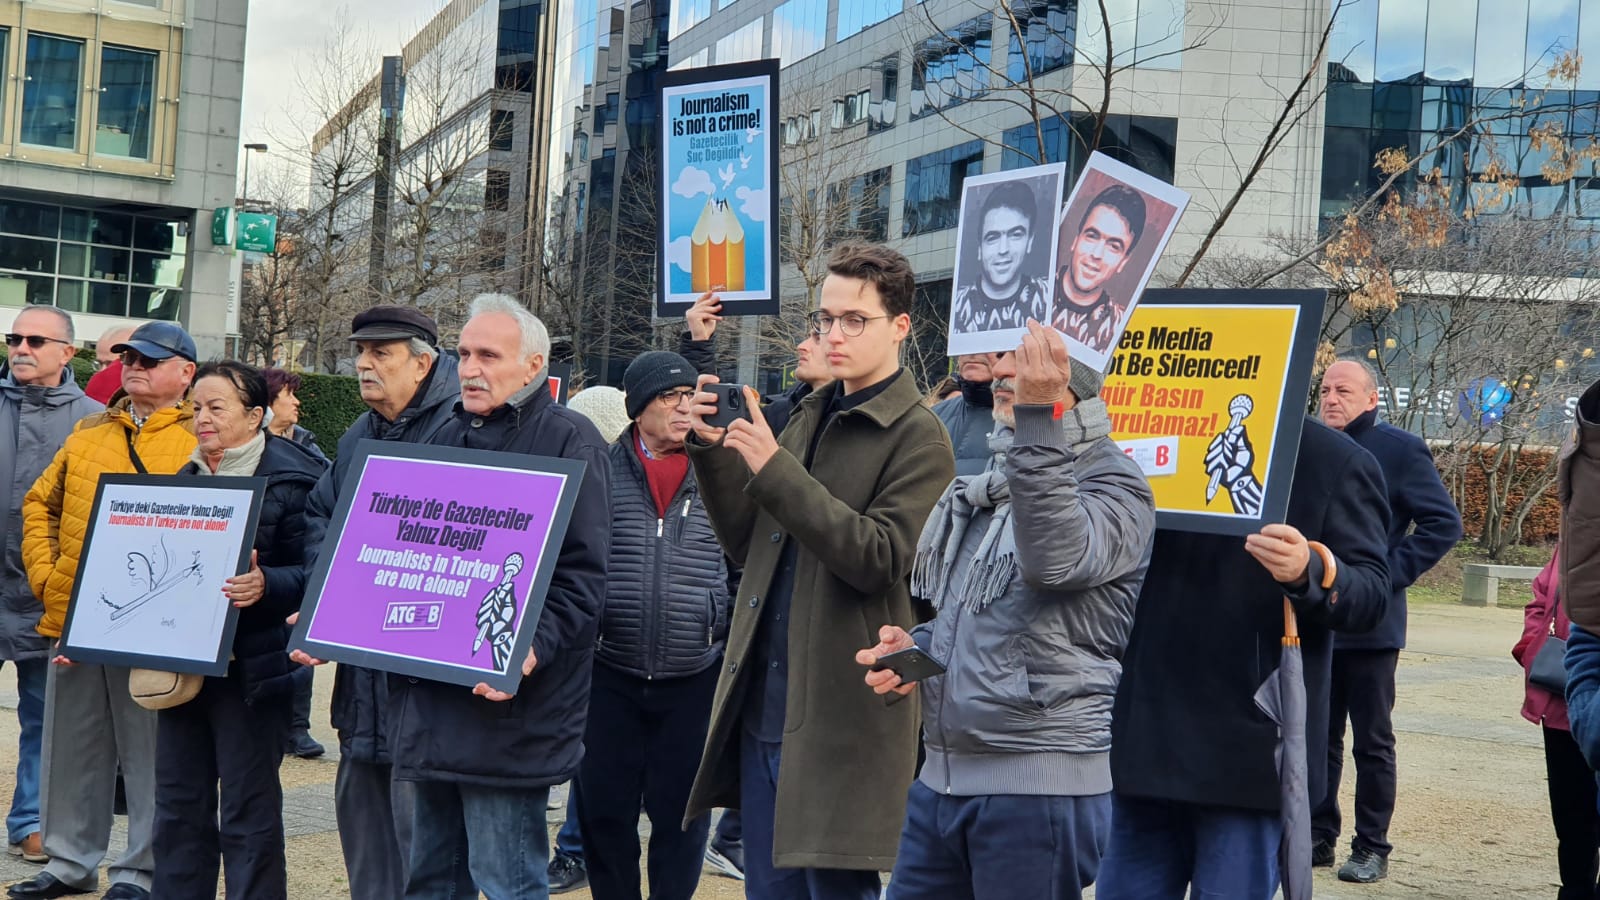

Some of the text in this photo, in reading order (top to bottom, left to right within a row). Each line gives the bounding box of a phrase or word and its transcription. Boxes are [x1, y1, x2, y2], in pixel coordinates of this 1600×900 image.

[680, 92, 749, 117] Journalism
[673, 108, 760, 137] is not a crime!
[690, 133, 739, 150] Gazetecilik
[687, 150, 704, 164] Suç
[1118, 326, 1214, 351] ee Media
[1126, 353, 1154, 377] Be
[1157, 353, 1261, 380] Silenced!
[1100, 381, 1205, 409] gür Basın
[1107, 410, 1219, 437] urulamaz!
[108, 513, 229, 532] Journalists in Turkey are not alone!
[151, 501, 190, 516] Gazeteciler
[191, 504, 212, 518] Yalnız
[212, 505, 235, 520] Değil!
[368, 491, 534, 532] Türkiye'de Gazeteciler
[396, 519, 488, 552] Yalnız Değil!
[357, 543, 500, 583] Journalists in Turkey
[374, 569, 472, 598] are not alone!
